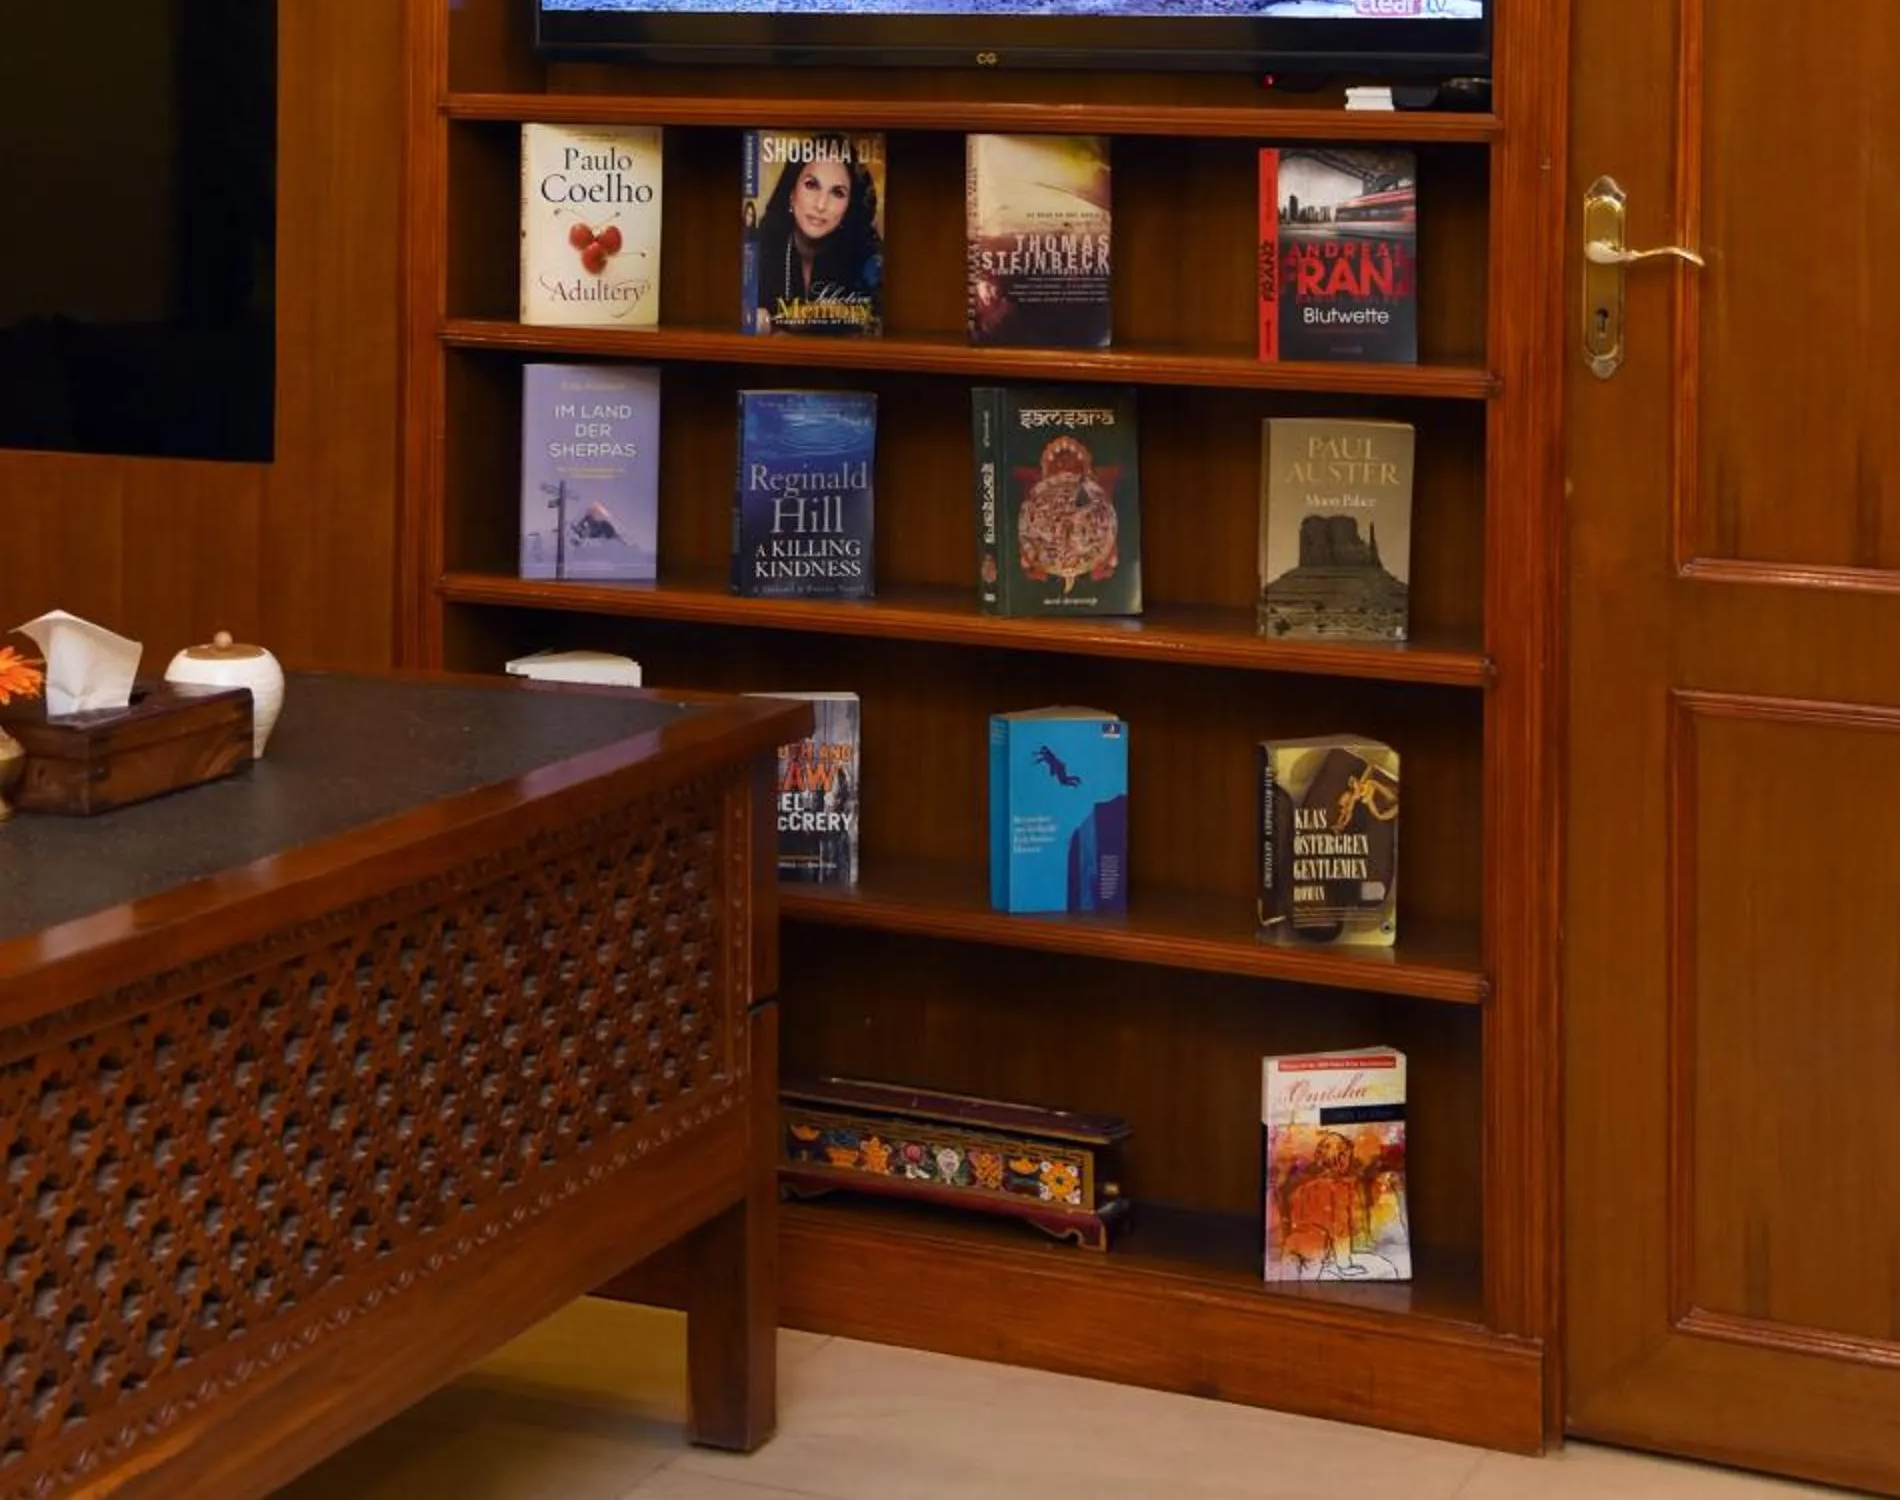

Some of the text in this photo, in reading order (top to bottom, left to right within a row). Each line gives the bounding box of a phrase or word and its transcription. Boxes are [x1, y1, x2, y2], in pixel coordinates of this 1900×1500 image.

[976, 51, 997, 66] CG
[563, 147, 632, 171] Paulo
[763, 137, 852, 164] SHOBHAA
[541, 173, 653, 203] Coelho
[1015, 233, 1111, 253] THOMAS
[981, 251, 1111, 272] STEINBECK
[547, 277, 649, 310] Adultery
[1303, 307, 1390, 325] Blutwette
[555, 404, 632, 420] IM LAND
[575, 423, 612, 438] DER
[549, 443, 637, 458] SHERPAS
[1308, 436, 1380, 460] PAUL
[750, 461, 867, 498] Reginald
[1285, 461, 1400, 485] AUSTER
[770, 495, 844, 534] Hill
[755, 539, 861, 558] A KILLING
[755, 560, 862, 578] KINDNESS
[777, 812, 852, 832] cCRERY
